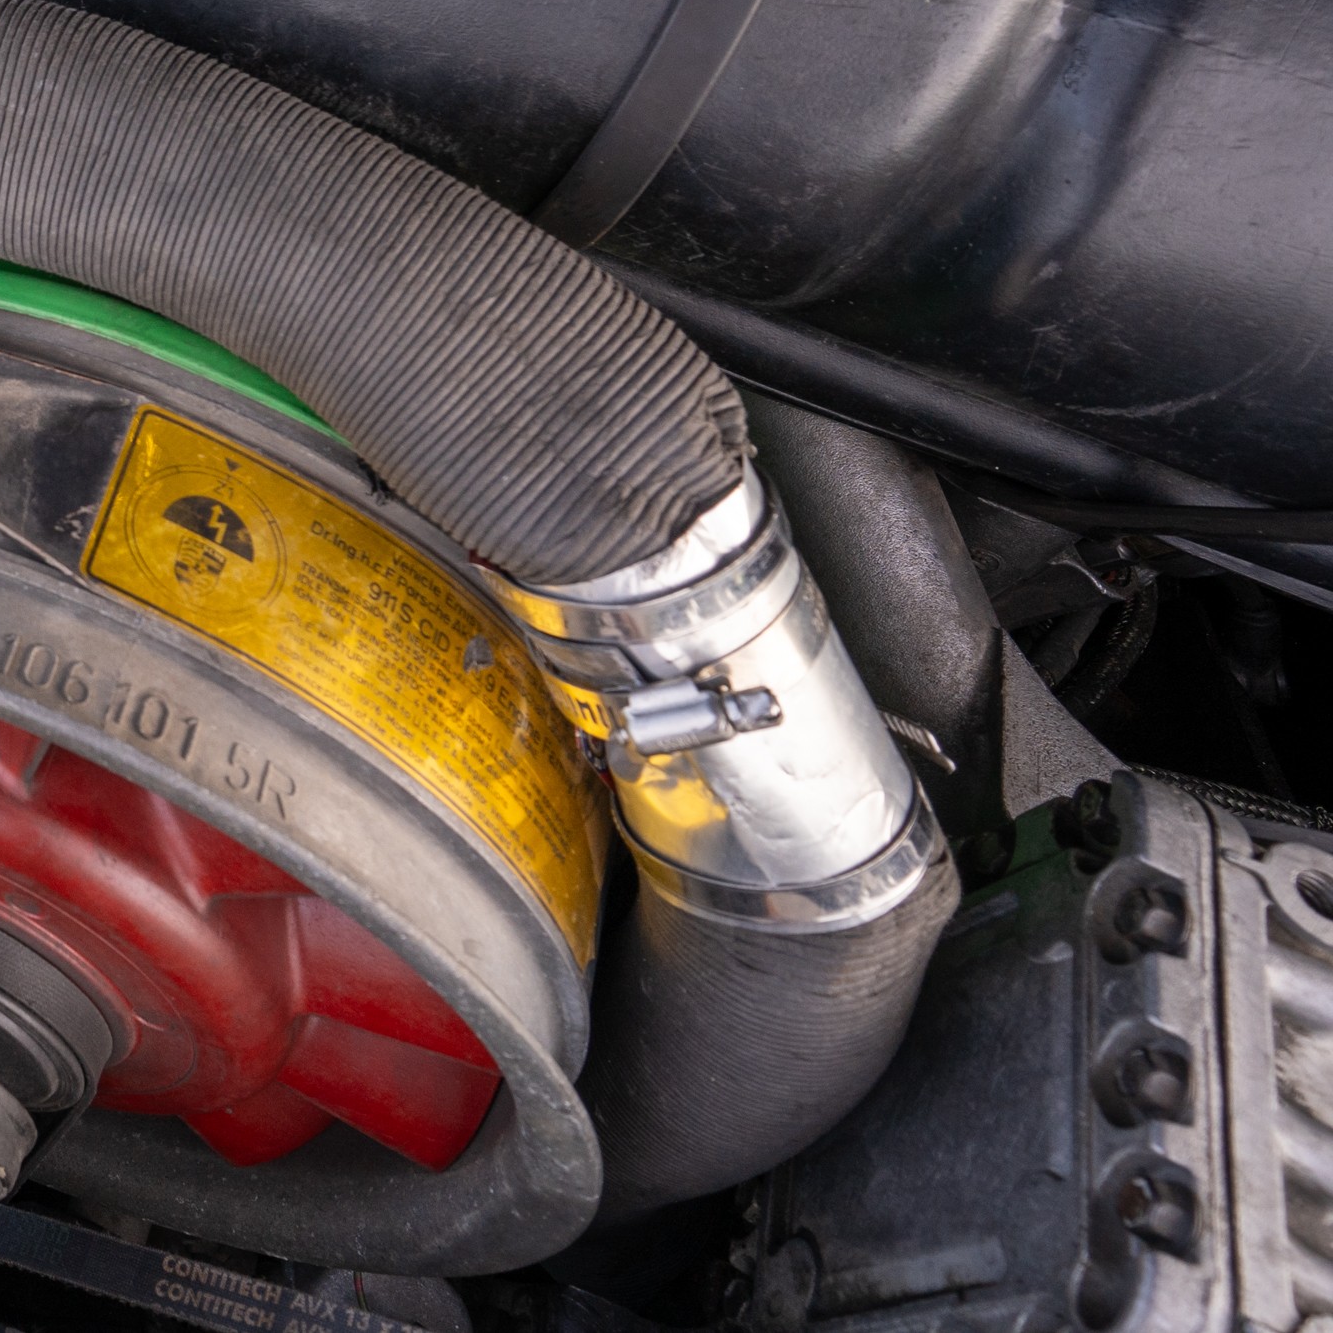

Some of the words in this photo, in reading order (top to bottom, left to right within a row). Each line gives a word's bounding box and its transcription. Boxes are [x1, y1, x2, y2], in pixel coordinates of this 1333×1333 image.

[393, 556, 441, 597] Vehicle
[369, 582, 397, 612] 911
[399, 602, 414, 624] S
[419, 619, 450, 652] CID
[2, 633, 97, 706] 106
[107, 681, 202, 761] 101
[223, 739, 298, 821] 5R
[152, 1277, 277, 1332] CONTITECH
[160, 1253, 284, 1306] CONTITECH
[289, 1292, 339, 1322] AVX
[343, 1307, 372, 1331] 13
